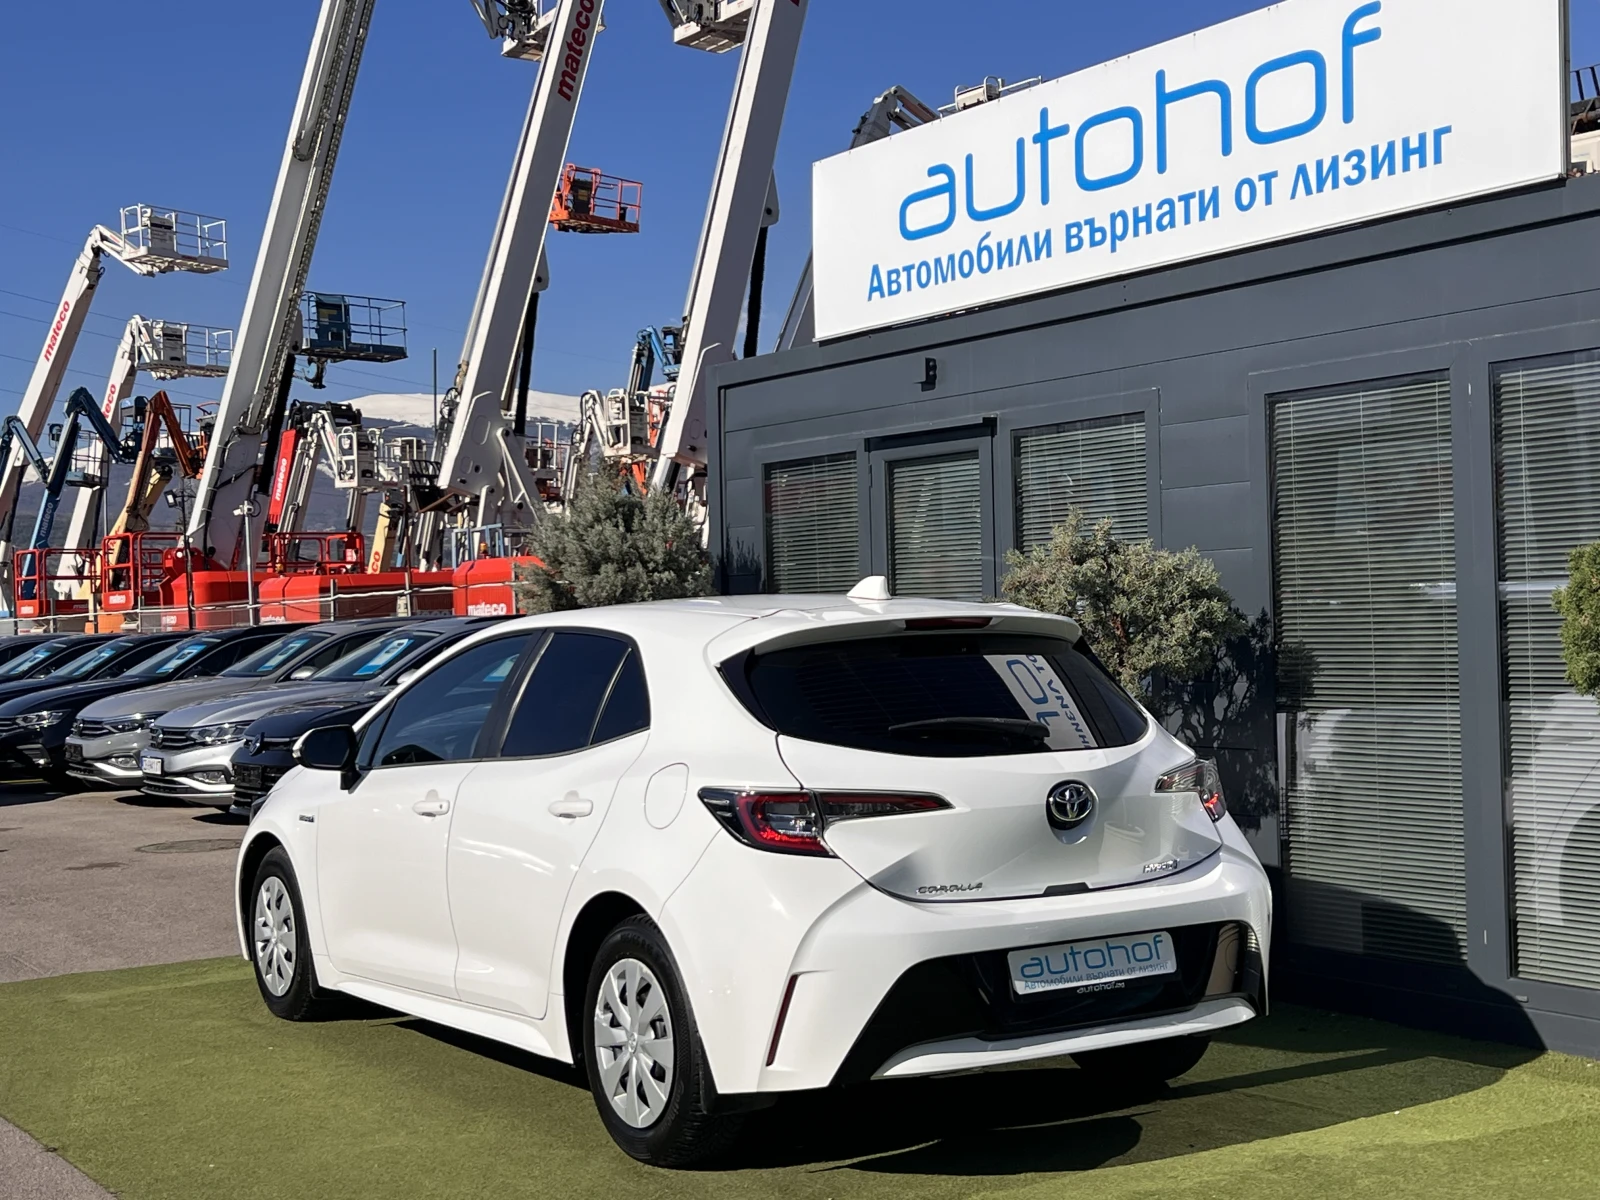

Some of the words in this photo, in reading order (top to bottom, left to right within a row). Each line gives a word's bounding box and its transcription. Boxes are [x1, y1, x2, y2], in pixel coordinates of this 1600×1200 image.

[557, 0, 595, 102] mateco
[899, 0, 1382, 241] autohof
[867, 228, 1053, 302] Автомобили
[1065, 186, 1220, 254] върнати
[1234, 170, 1279, 212] от
[1290, 124, 1453, 200] лизинг
[43, 300, 70, 362] mateco
[275, 457, 288, 501] mateco
[467, 601, 507, 616] mateco
[917, 882, 983, 894] COROLLA
[1020, 934, 1164, 979] autohof
[1024, 973, 1084, 991] Автомобили
[1086, 968, 1125, 982] върнати
